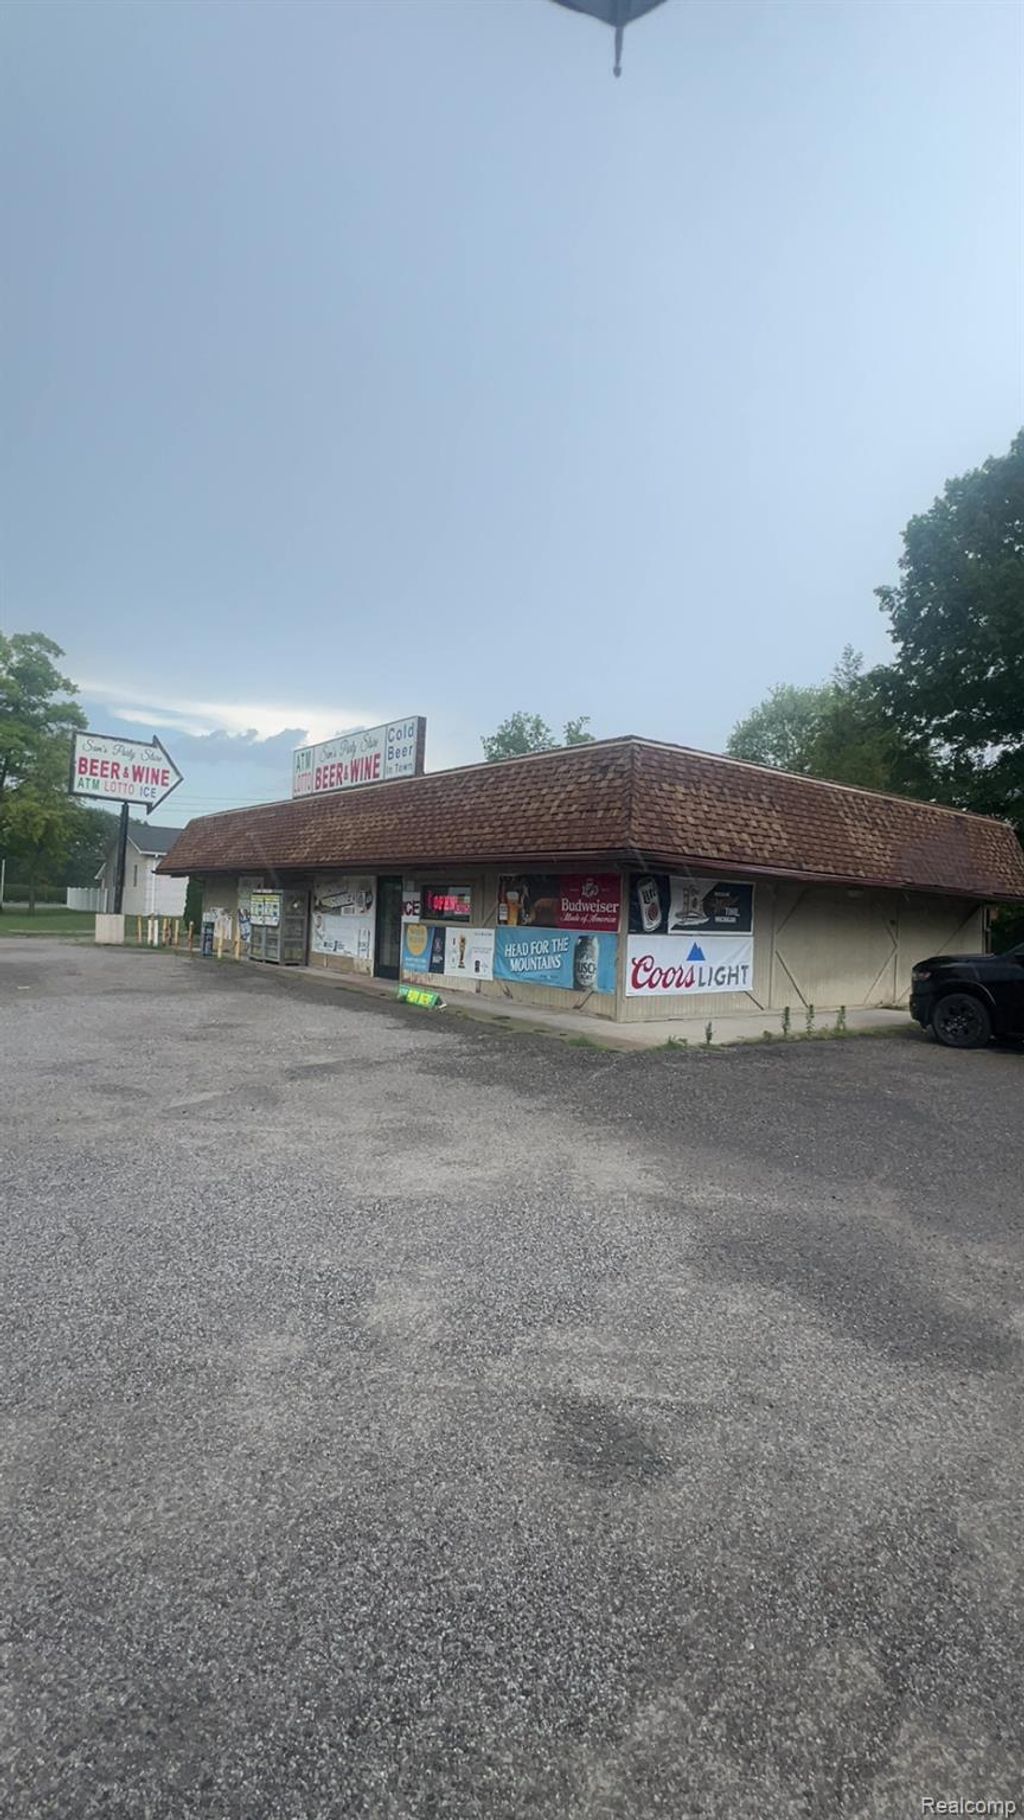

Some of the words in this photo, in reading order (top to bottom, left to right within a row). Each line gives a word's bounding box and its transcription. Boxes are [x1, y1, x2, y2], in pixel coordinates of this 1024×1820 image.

[387, 722, 415, 742] Cold
[295, 750, 311, 773] ATM
[387, 745, 413, 760] Beer
[78, 756, 120, 780] BEER
[123, 766, 129, 778] &
[132, 764, 170, 787] WINE
[315, 762, 343, 790] BEER
[350, 752, 381, 783] WINE
[77, 777, 100, 790] ATM
[104, 781, 135, 795] LOTTO
[140, 786, 157, 798] ICE
[561, 897, 619, 913] Budweiser
[504, 941, 529, 958] HEAD
[530, 940, 549, 955] FOR
[551, 937, 569, 952] THE
[509, 954, 561, 972] MOUNTAINS
[631, 955, 696, 989] Coors
[698, 965, 749, 987] LIGHT
